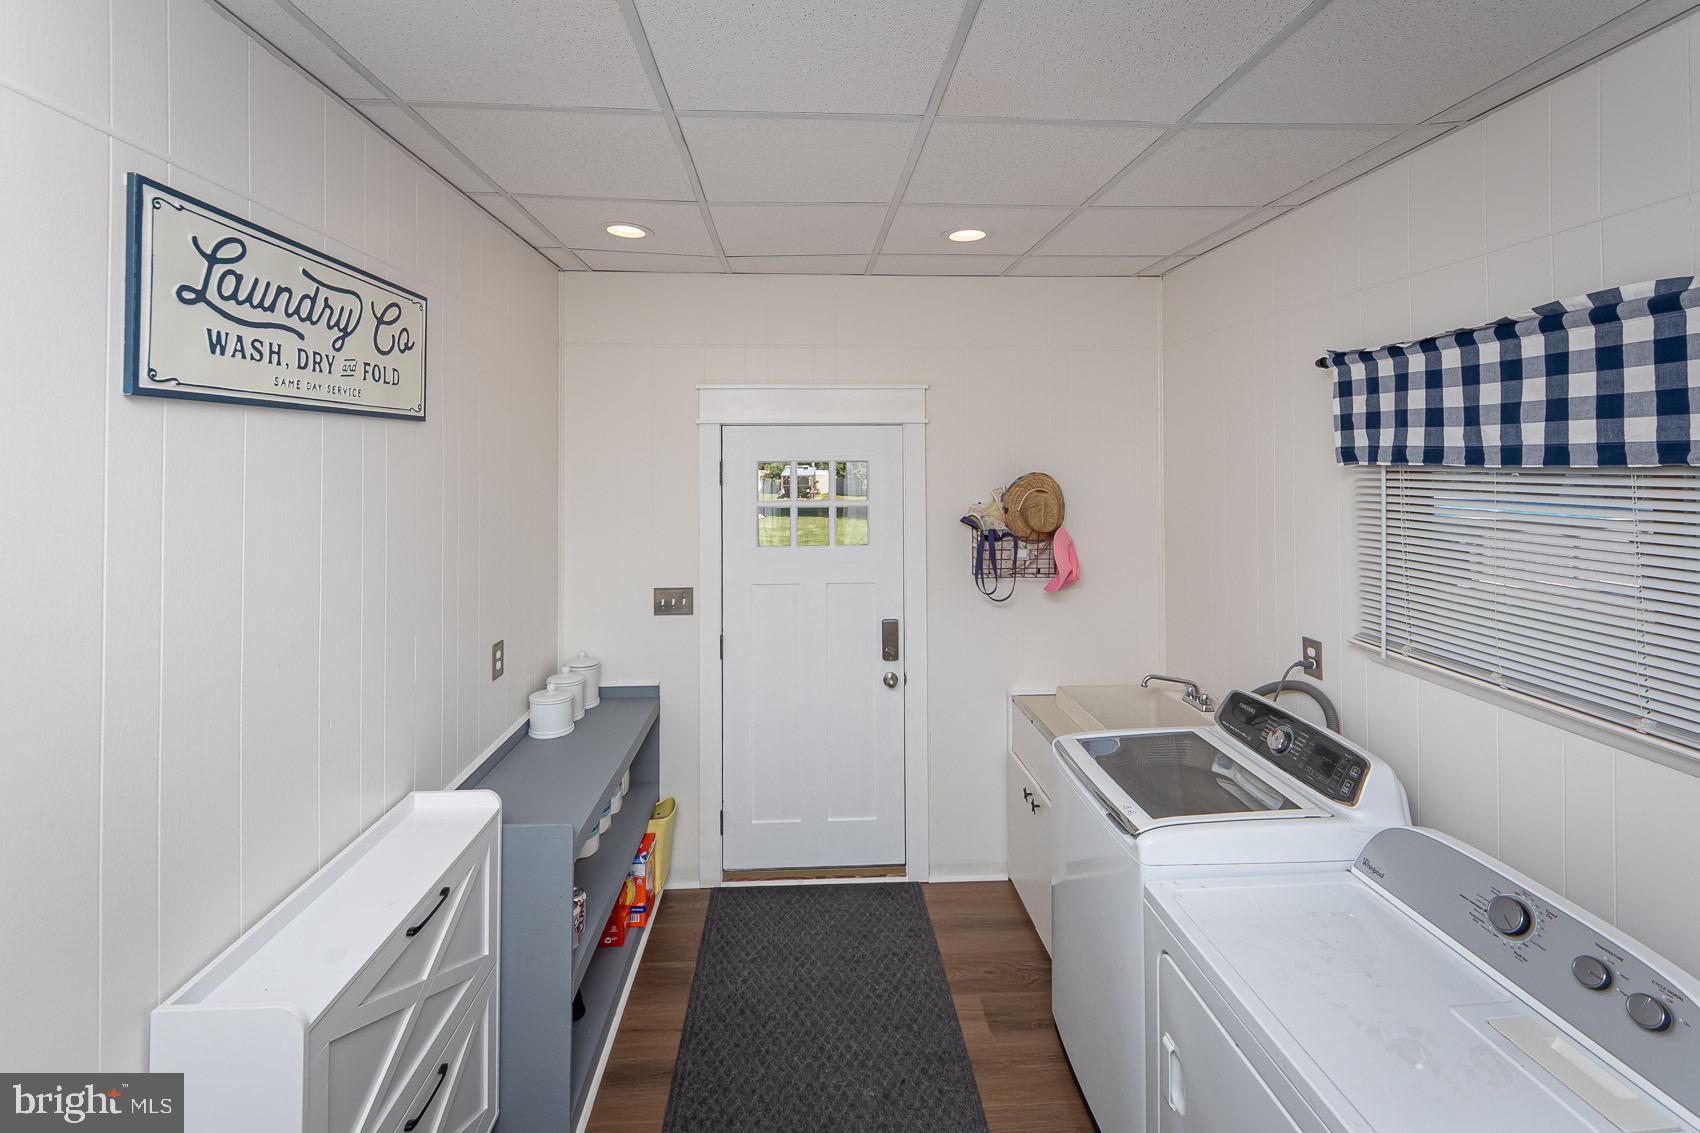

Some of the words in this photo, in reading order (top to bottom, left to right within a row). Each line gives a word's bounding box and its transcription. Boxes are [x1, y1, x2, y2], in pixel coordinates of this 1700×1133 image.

[175, 235, 363, 352] Laundry
[371, 300, 415, 356] Co
[206, 327, 290, 370] WASH,
[296, 347, 336, 375] DRY
[340, 358, 358, 375] and
[362, 361, 401, 386] FOLD
[273, 376, 301, 390] SAME
[306, 380, 323, 392] DAY
[326, 384, 362, 398] SERVICE
